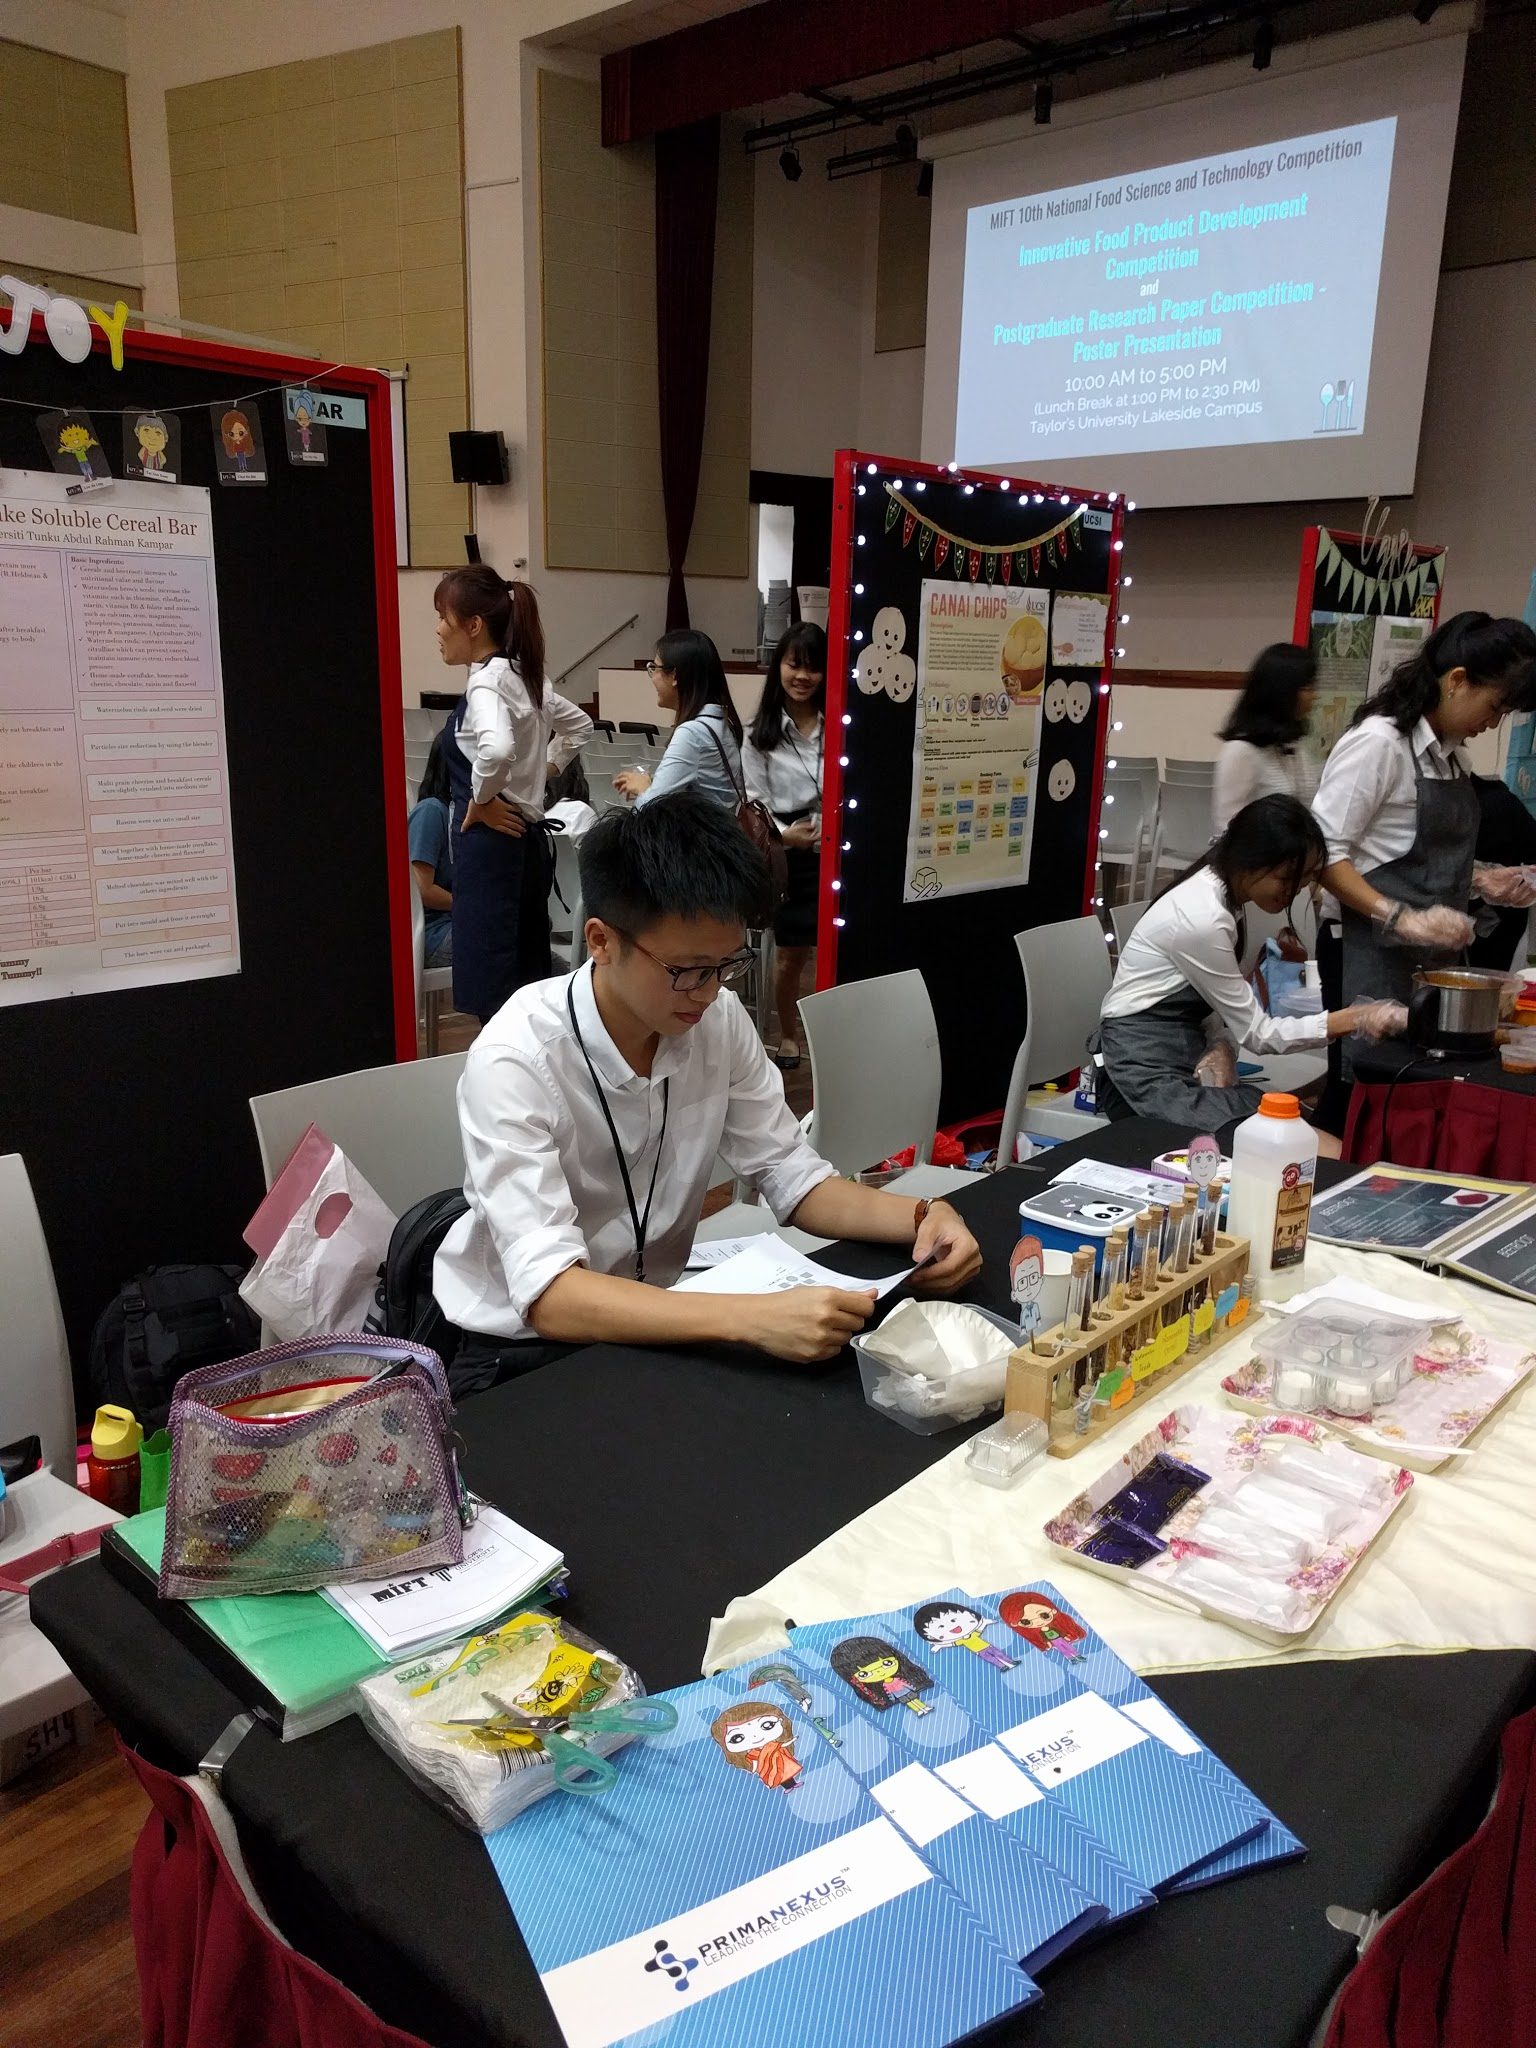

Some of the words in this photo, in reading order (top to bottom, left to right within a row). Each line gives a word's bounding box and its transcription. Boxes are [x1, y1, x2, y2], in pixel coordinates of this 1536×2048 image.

[991, 210, 1014, 230] MIFT
[1019, 205, 1043, 224] 10th
[1046, 194, 1092, 222] National
[1095, 188, 1122, 209] Food
[1126, 178, 1171, 203] Science
[1175, 173, 1197, 193] and
[1201, 156, 1273, 187] Technology
[1277, 140, 1362, 173] Competition
[1019, 235, 1090, 267] Innovative
[1095, 225, 1129, 253] Food
[1134, 214, 1193, 245] Product
[1199, 193, 1309, 234] Development
[1105, 247, 1199, 281] Competition
[1140, 279, 1159, 298] and
[0, 275, 129, 371] JOY
[994, 314, 1084, 346] Postgraduate
[1089, 302, 1156, 332] Research
[1161, 296, 1207, 324] Paper
[1211, 279, 1314, 316] Competition
[1073, 340, 1118, 363] Poster
[1124, 325, 1222, 357] Presentation
[1065, 376, 1105, 394] 10:00
[1109, 371, 1135, 387] AM
[1139, 367, 1155, 383] to
[1160, 363, 1195, 384] 5:00
[1200, 357, 1227, 375] PM
[1034, 399, 1074, 418] (Lunch
[1078, 394, 1113, 412] Break
[1116, 392, 1129, 407] at
[1131, 390, 1157, 405] 1:00
[1160, 386, 1182, 403] PM
[1184, 384, 1198, 399] to
[1201, 384, 1230, 401] 2:30
[1232, 378, 1260, 394] PM)
[1030, 417, 1075, 436] Taylor's
[1078, 410, 1139, 430] University
[1142, 404, 1202, 424] Lakeside
[1205, 399, 1263, 419] Campus
[32, 508, 101, 529] Soluble
[107, 513, 162, 533] Cereal
[168, 518, 197, 536] Bar
[1084, 514, 1102, 526] UCSI
[27, 531, 59, 542] Tunku
[63, 534, 91, 545] Abdul
[95, 536, 134, 547] Rahman
[137, 539, 174, 550] Kampar
[931, 593, 969, 617] CANAI
[974, 596, 1007, 619] CHIPS
[0, 967, 42, 980] Tummy!!
[455, 1545, 494, 1571] UNIVERSITY
[370, 1577, 428, 1602] MIFT
[397, 1664, 426, 1682] Soft
[698, 1876, 846, 1958] PRIMANEXUS
[703, 1935, 755, 1967] LEADING
[755, 1921, 780, 1940] THE
[781, 1884, 852, 1925] CONNECTION
